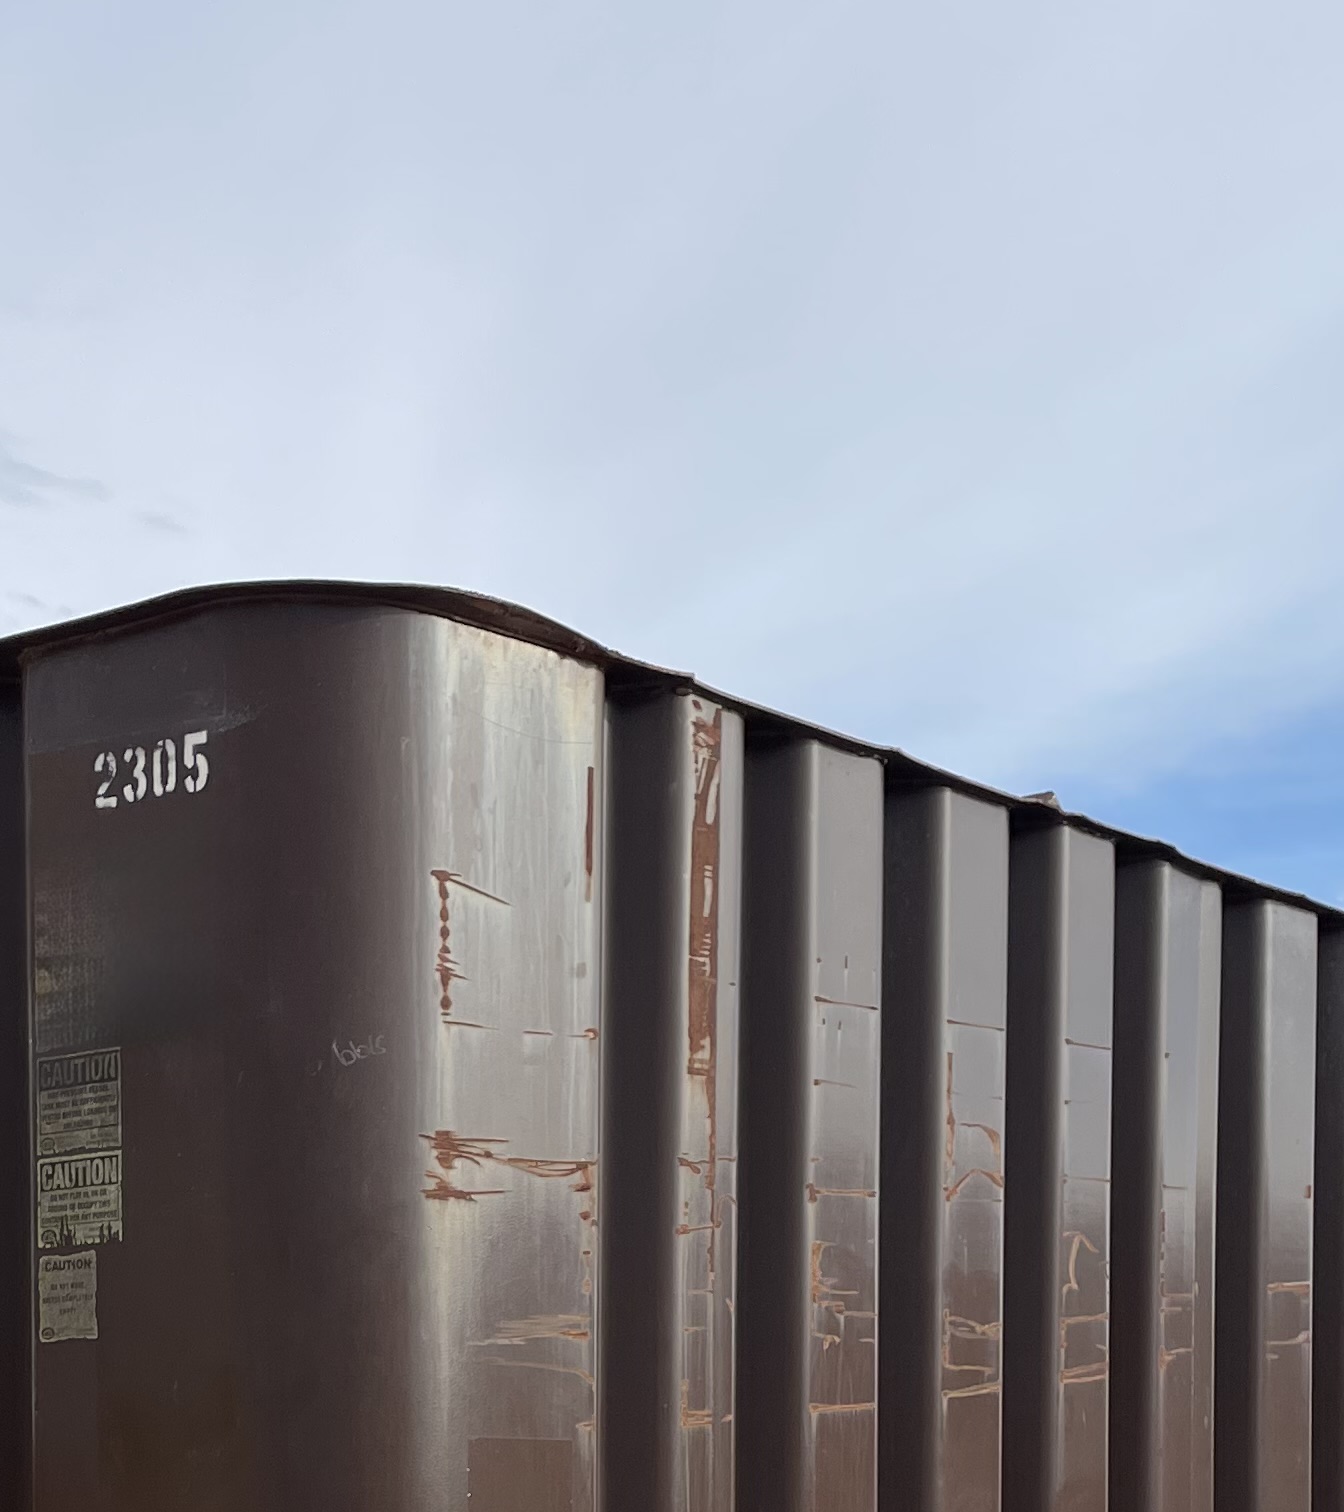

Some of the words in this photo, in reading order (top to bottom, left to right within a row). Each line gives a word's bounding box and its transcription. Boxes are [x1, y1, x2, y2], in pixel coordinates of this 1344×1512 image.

[94, 730, 209, 809] 2305
[40, 1052, 116, 1089] CAUTION
[41, 1157, 117, 1191] CAUTION
[44, 1258, 92, 1272] CAUTION
